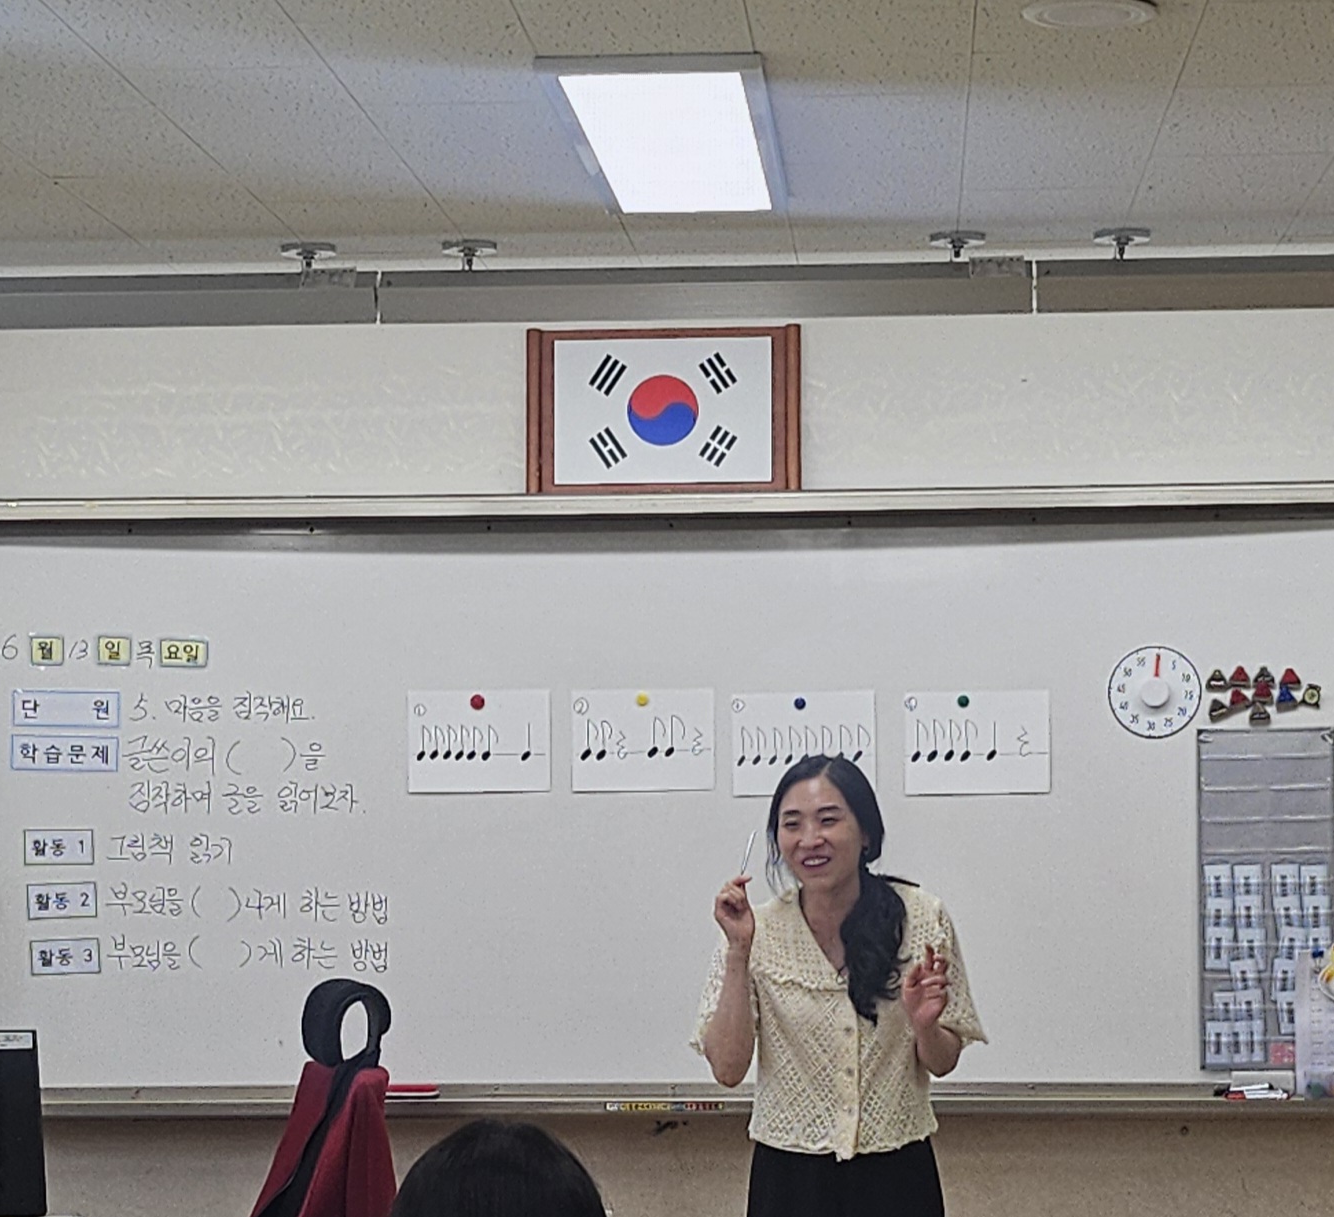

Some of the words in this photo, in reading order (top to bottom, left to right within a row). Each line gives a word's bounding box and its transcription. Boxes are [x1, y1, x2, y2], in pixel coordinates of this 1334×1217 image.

[2, 634, 17, 660] 6
[37, 640, 54, 660] 월
[68, 639, 89, 660] 13
[104, 639, 121, 660] 일
[136, 641, 155, 669] 목
[164, 645, 199, 663] 요일
[129, 693, 156, 722] 5.
[164, 694, 222, 723] 마음을
[232, 690, 315, 724] 짐작해요.
[19, 743, 110, 766] 학습문제
[122, 735, 216, 777] 글쓴이의
[129, 779, 212, 815] 짐작하며
[222, 783, 264, 816] 글을
[278, 780, 367, 815] 읽어보자.
[107, 834, 174, 864] 그림책
[190, 834, 233, 865] 읽기
[80, 893, 90, 907] 2
[299, 886, 341, 923] 하는
[348, 891, 389, 925] 방법
[83, 949, 93, 963] 3
[291, 937, 338, 970] 하는
[352, 939, 389, 974] 방법
